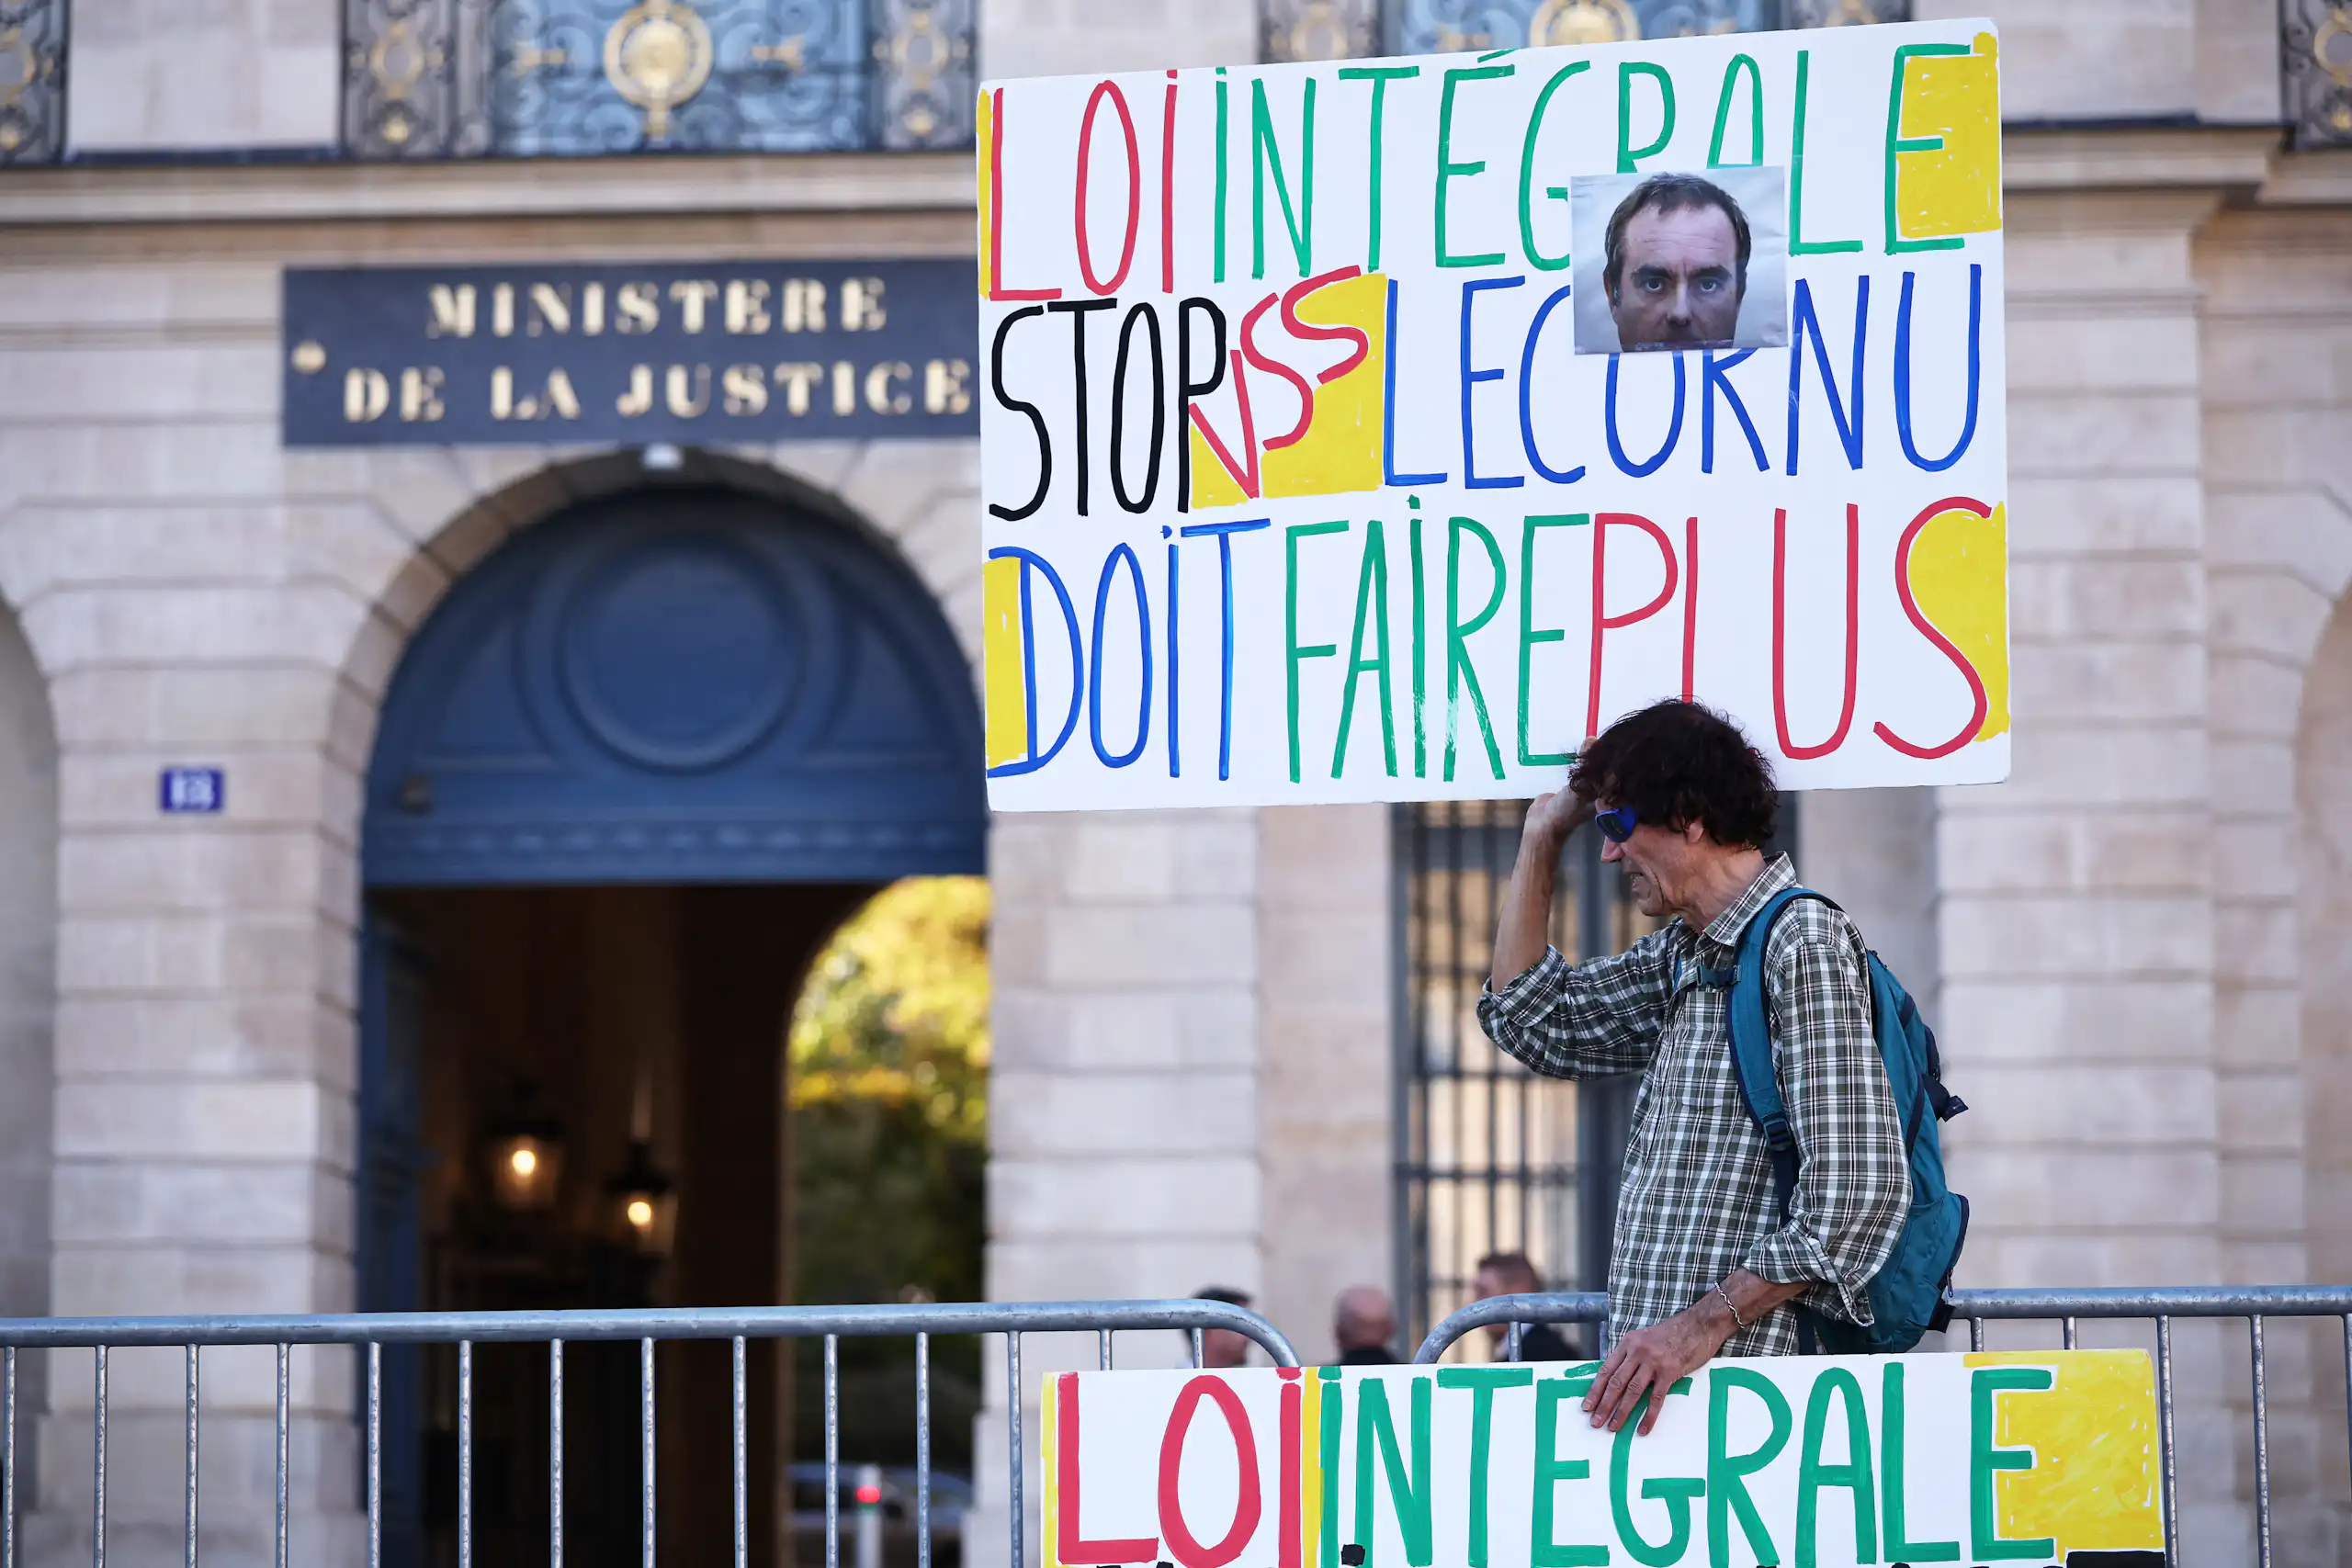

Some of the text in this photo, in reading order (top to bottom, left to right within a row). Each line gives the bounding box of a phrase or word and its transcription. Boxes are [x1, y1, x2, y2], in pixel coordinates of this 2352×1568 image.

[343, 358, 972, 423] DE LA JUSTICE
[988, 296, 1227, 522] STOP
[1383, 263, 1983, 490] LECORNU
